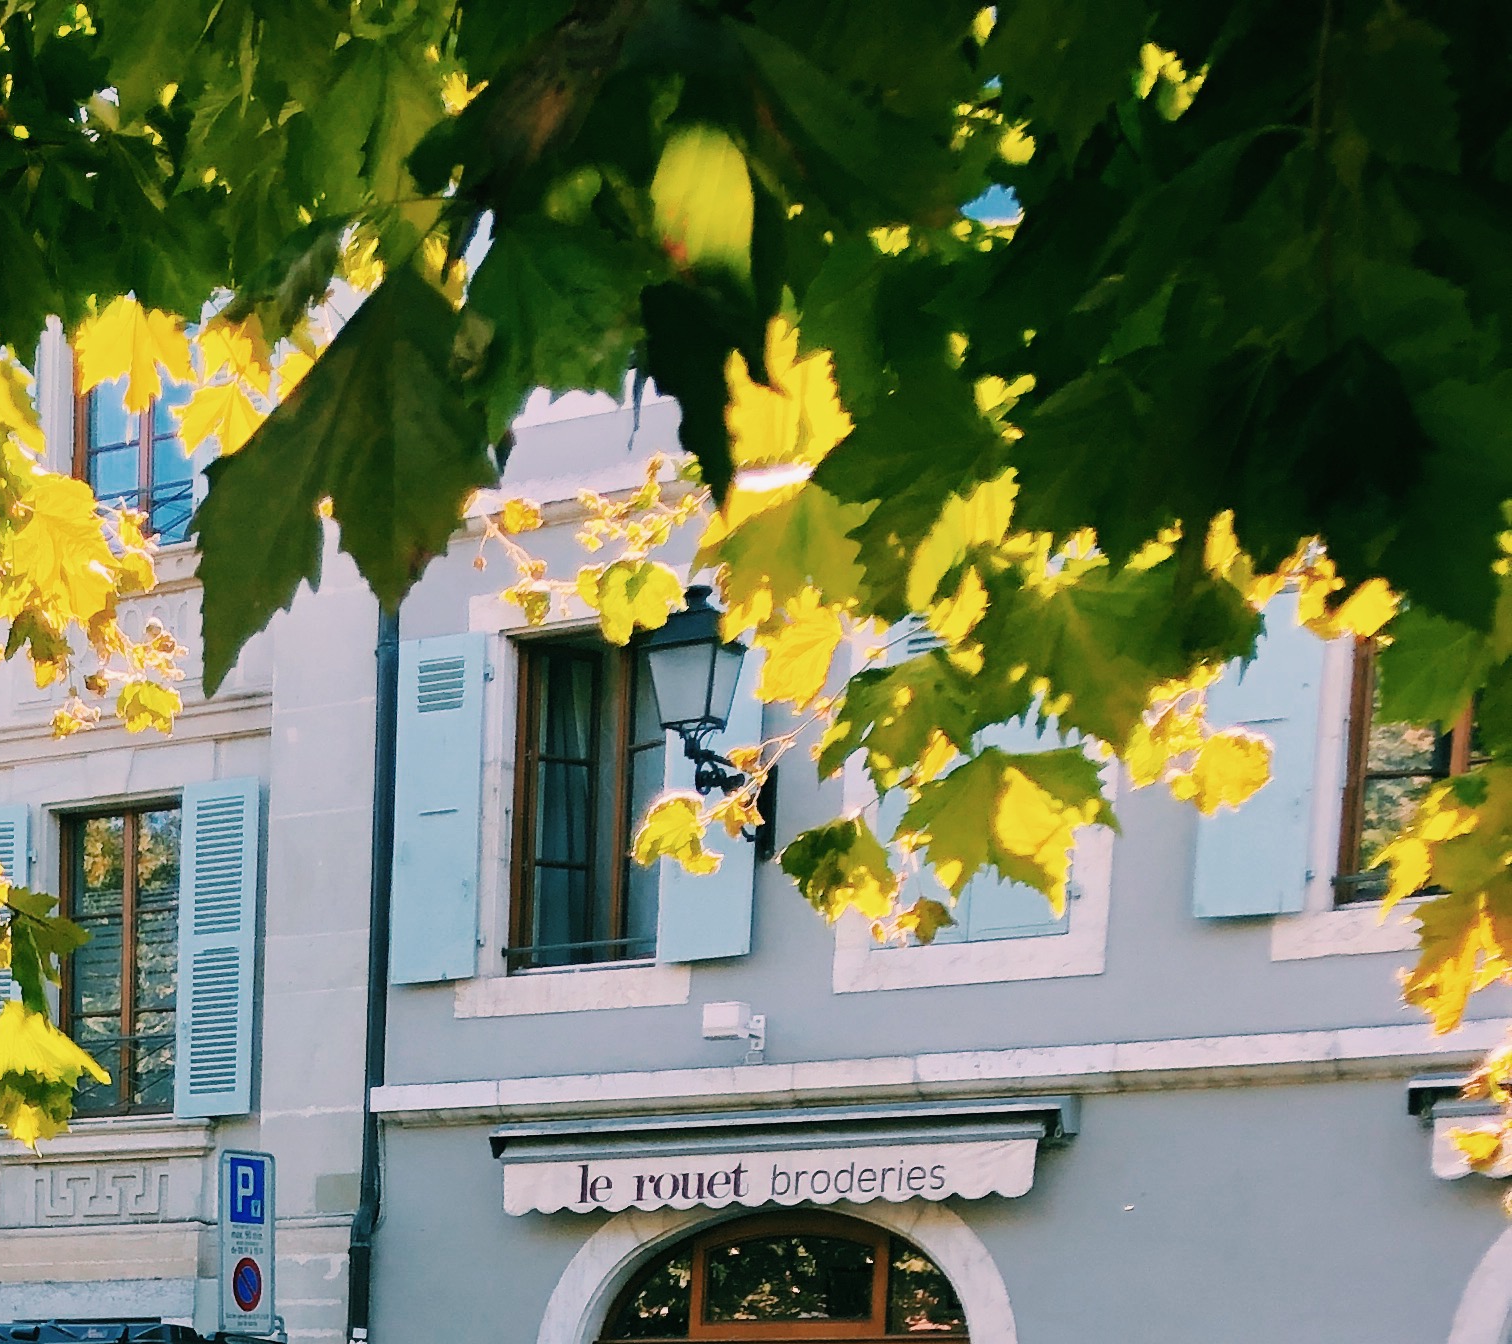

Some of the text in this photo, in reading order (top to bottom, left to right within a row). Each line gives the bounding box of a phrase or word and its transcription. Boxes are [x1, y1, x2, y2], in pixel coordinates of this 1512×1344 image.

[237, 1165, 254, 1213] P
[577, 1158, 948, 1204] le rouet broderies
